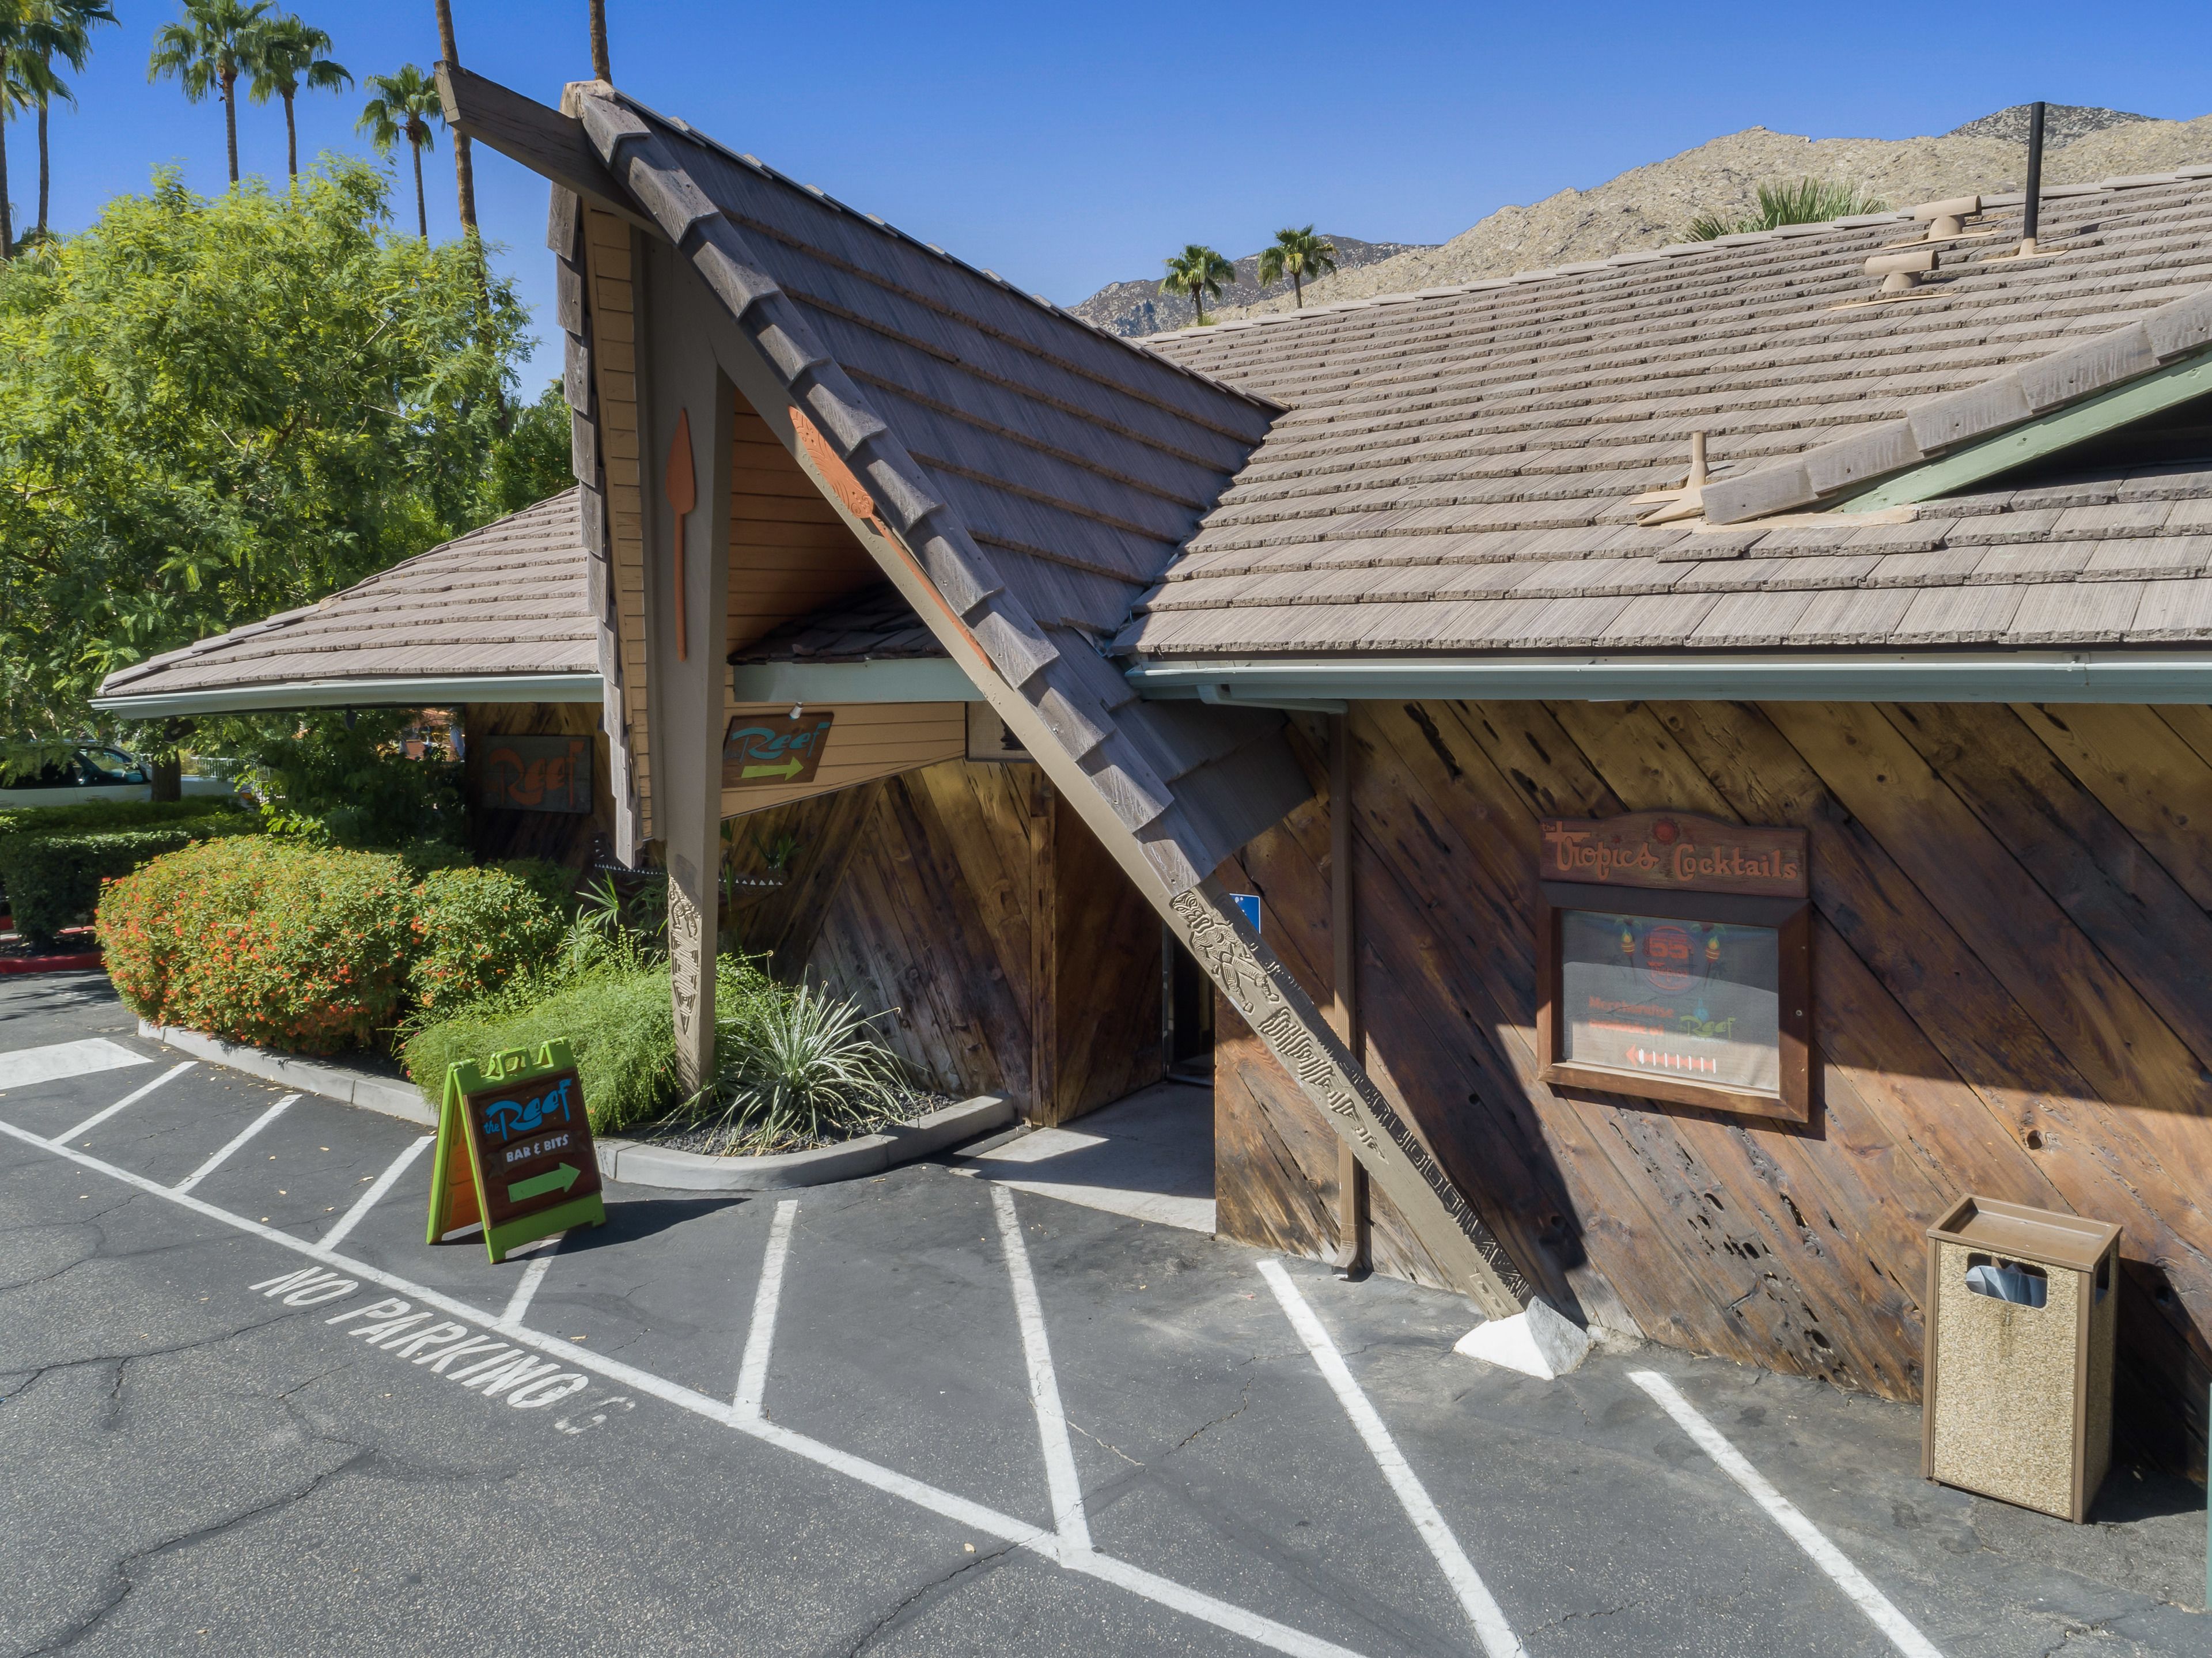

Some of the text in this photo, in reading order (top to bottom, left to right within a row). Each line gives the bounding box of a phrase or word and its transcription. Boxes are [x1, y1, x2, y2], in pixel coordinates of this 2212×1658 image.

[489, 740, 585, 806] Reef
[730, 722, 830, 764] Reef
[1541, 821, 1798, 881] the Tropics Cocktails
[1680, 1015, 1736, 1040] Reef
[483, 1078, 573, 1141] the Reef
[506, 1146, 531, 1163] BAR
[544, 1134, 569, 1151] BITS
[248, 1266, 589, 1409] NO PARKING
